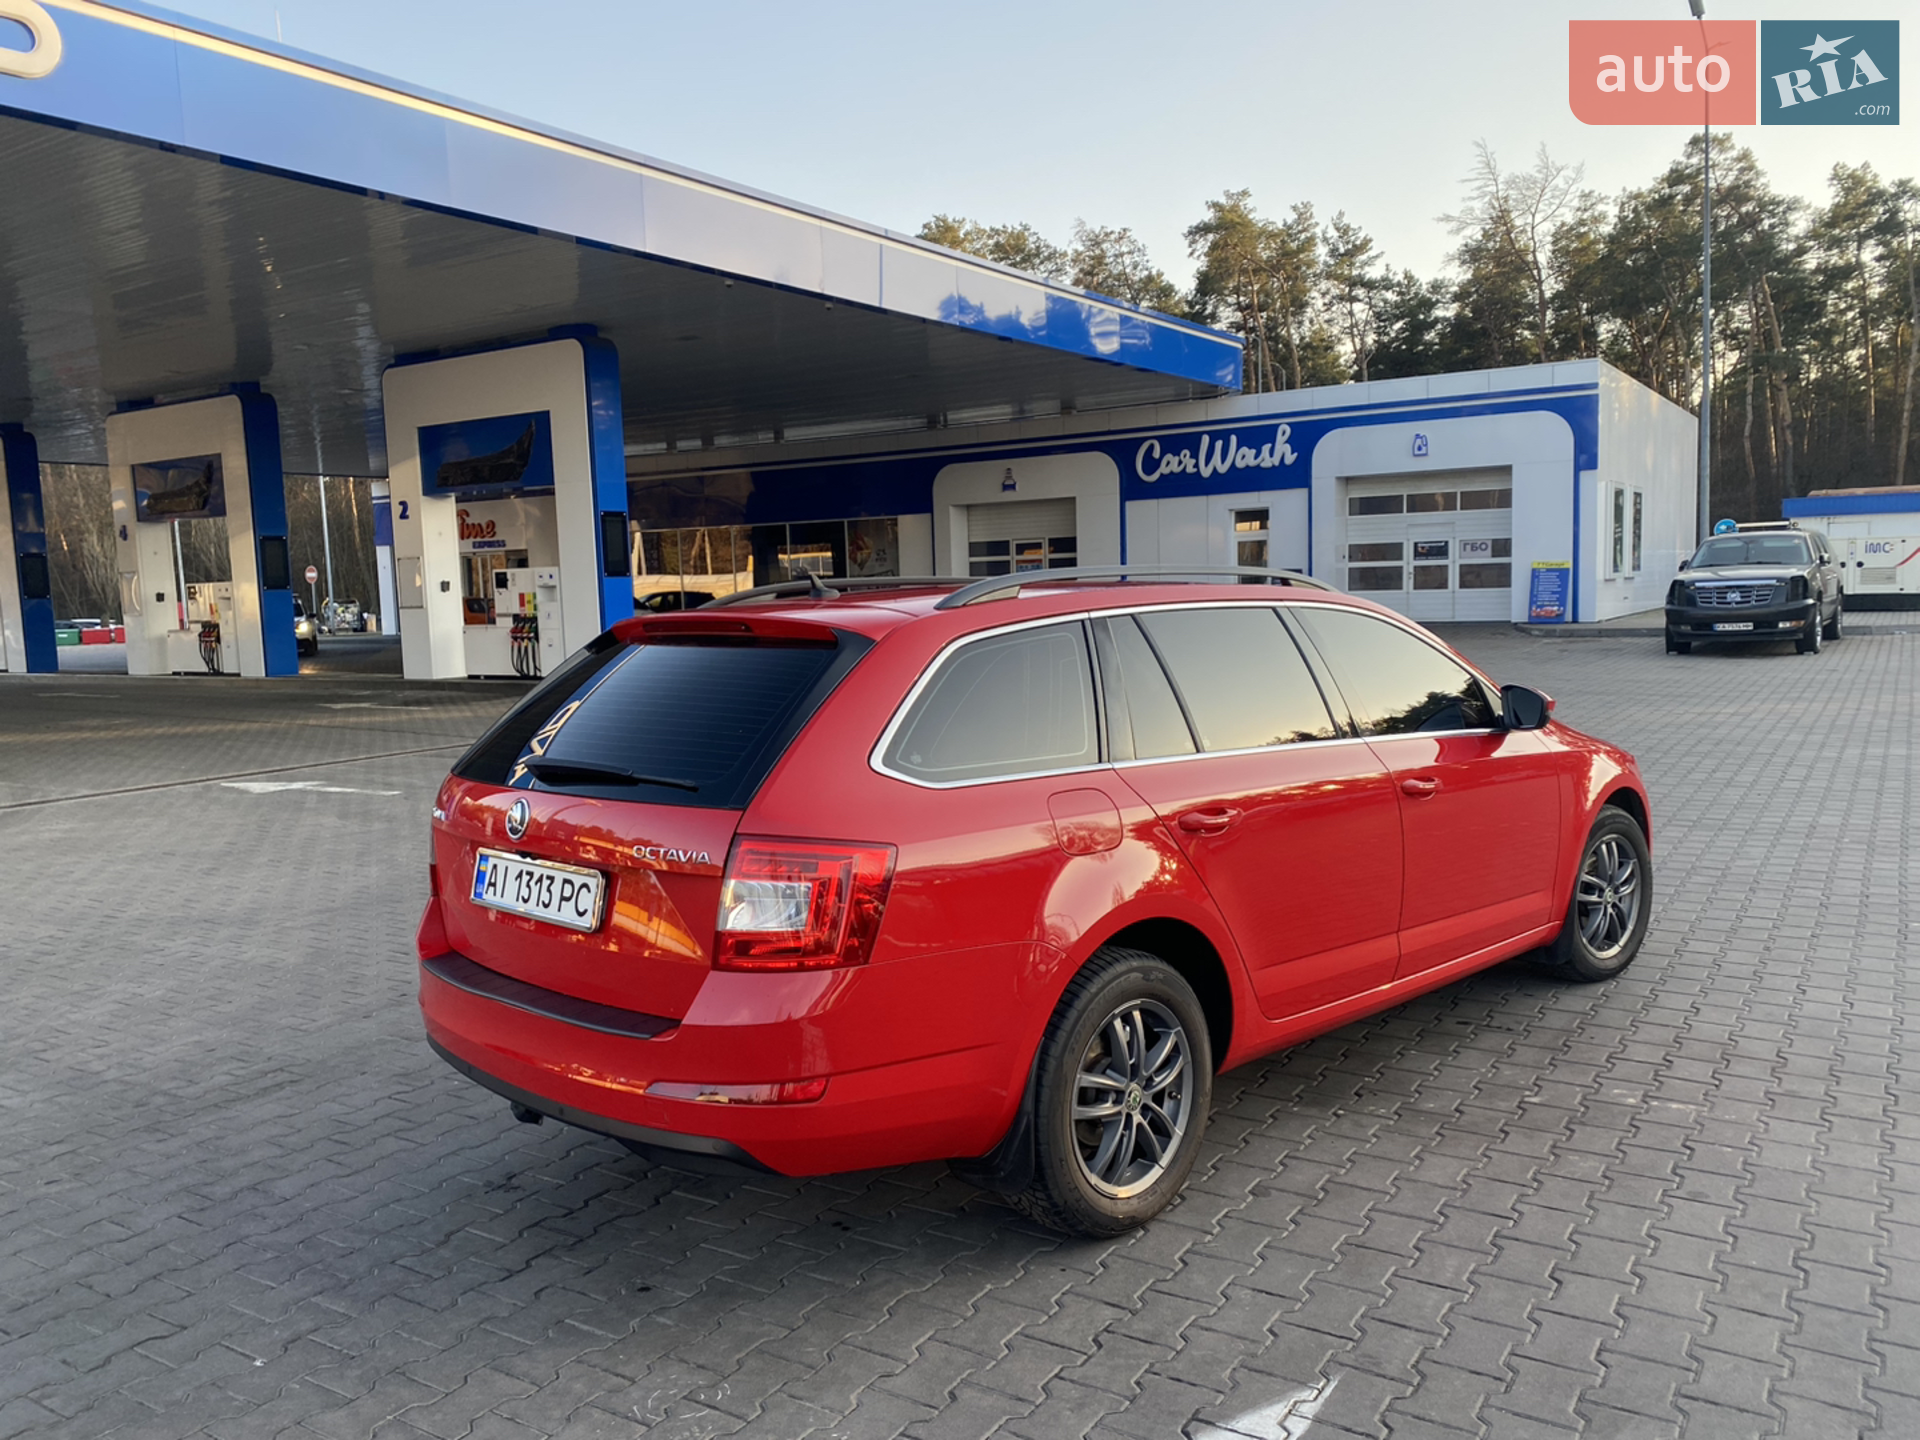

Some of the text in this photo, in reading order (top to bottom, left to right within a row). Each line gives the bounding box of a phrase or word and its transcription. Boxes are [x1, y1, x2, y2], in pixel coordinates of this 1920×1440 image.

[398, 500, 410, 520] 2
[1463, 541, 1489, 552] ГБО
[632, 845, 712, 865] OCTAVIA
[485, 863, 591, 917] AI 1313 PC
